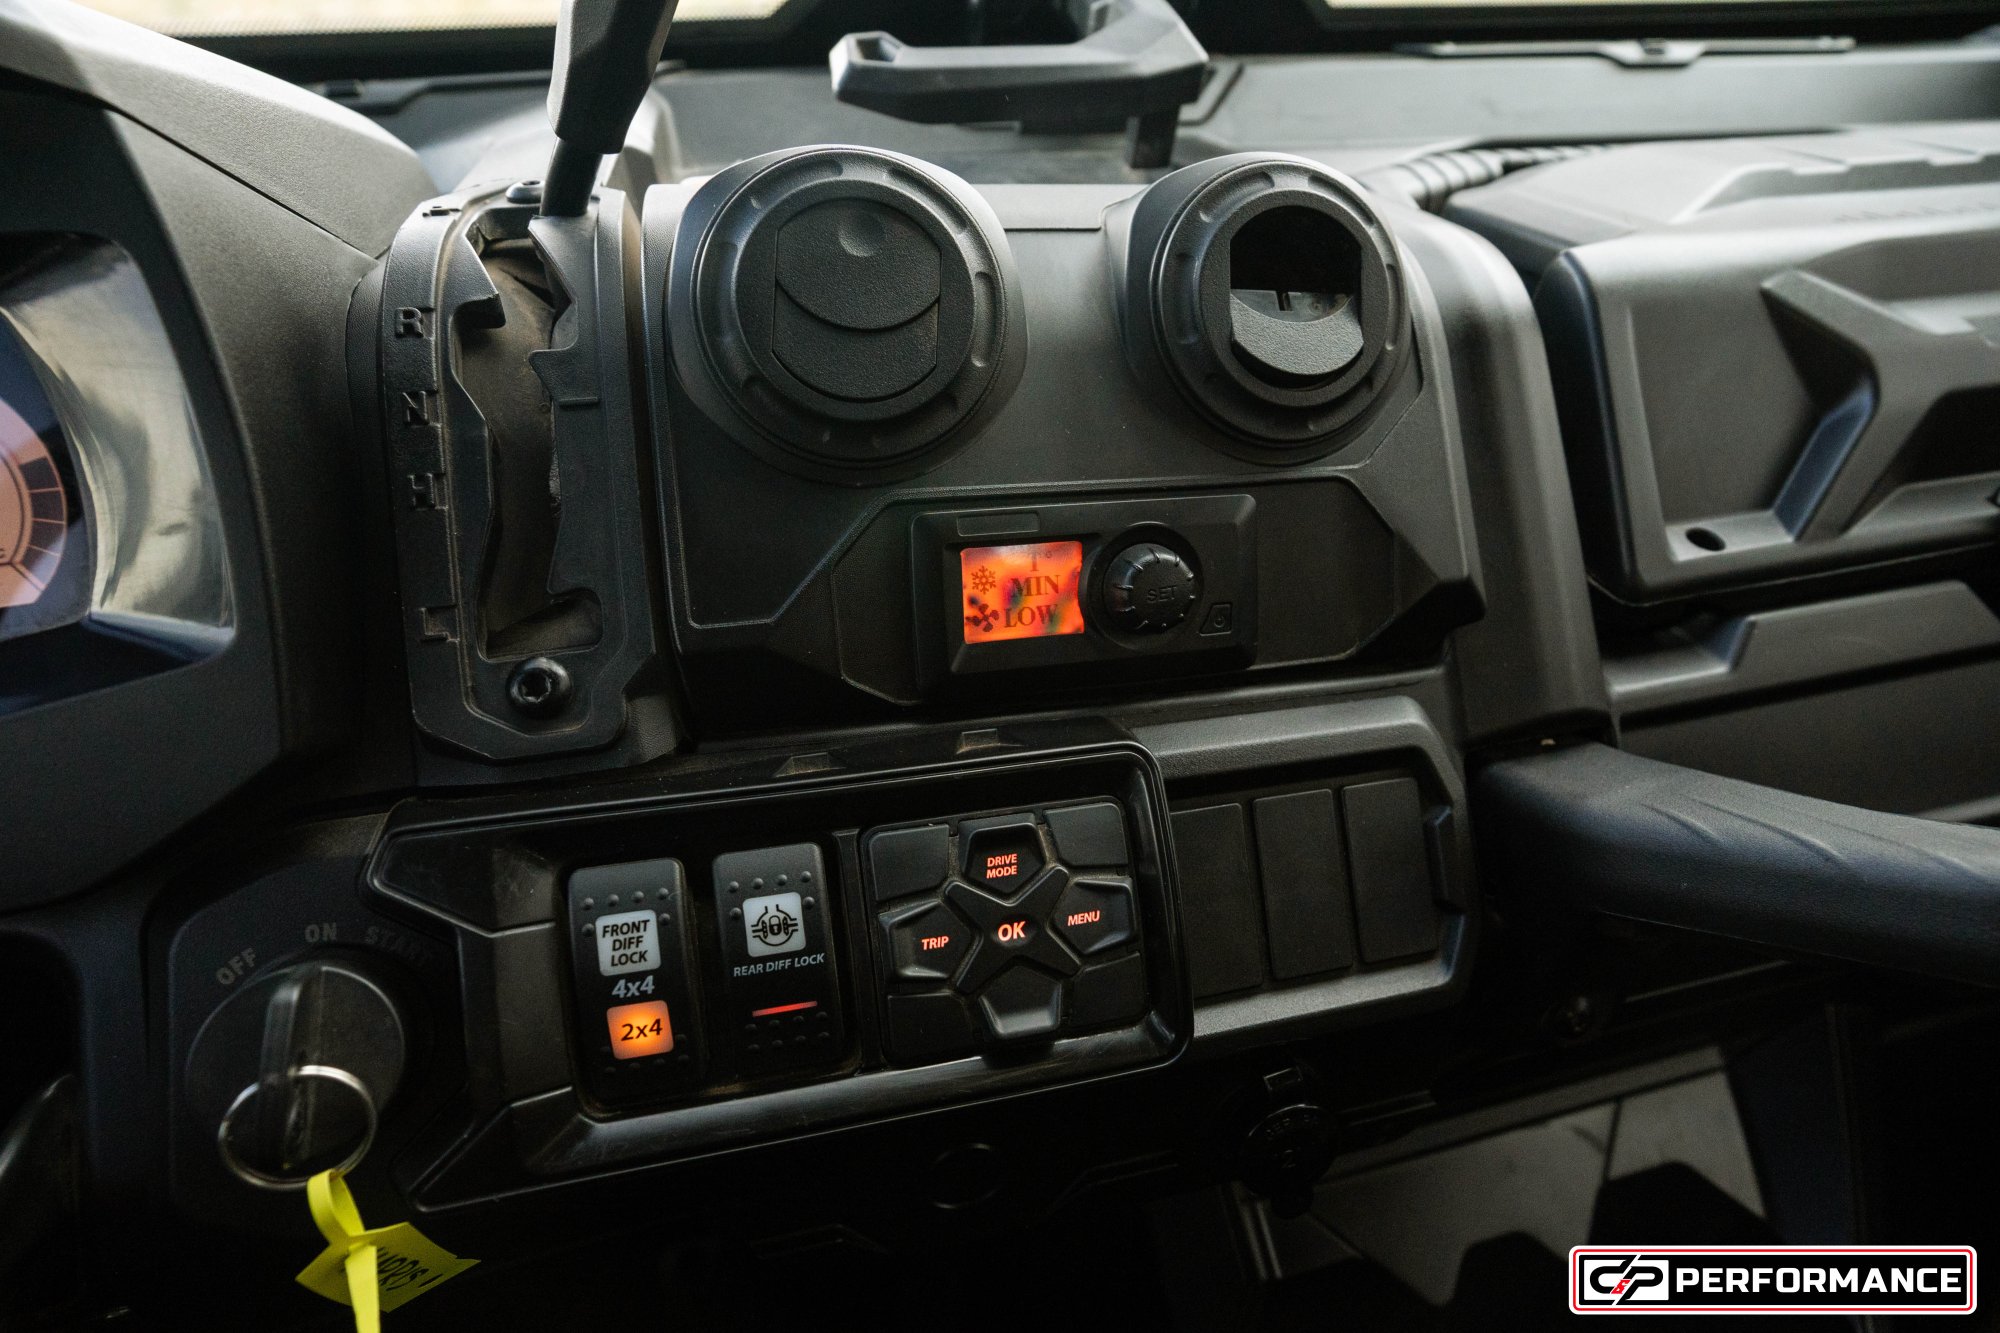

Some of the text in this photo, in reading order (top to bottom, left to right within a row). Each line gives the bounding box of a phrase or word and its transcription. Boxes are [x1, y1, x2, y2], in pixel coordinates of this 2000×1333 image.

[396, 307, 424, 338] R
[403, 391, 430, 424] N
[407, 473, 435, 509] H
[1011, 575, 1061, 598] MIN
[1147, 585, 1177, 603] SET
[419, 607, 450, 641] L
[1003, 603, 1058, 628] LOW
[986, 865, 1018, 879] MODE
[987, 853, 1018, 868] DRIVE
[602, 919, 651, 938] FRONT
[1067, 910, 1101, 926] MENU
[304, 921, 337, 944] ON
[921, 935, 950, 950] TRIP
[997, 921, 1027, 942] OK
[612, 936, 644, 952] DIFF
[215, 946, 258, 985] OFF
[610, 950, 648, 967] LOCK
[733, 952, 825, 977] REAR DIFF LOCK
[611, 974, 656, 999] 4x4
[620, 1018, 664, 1042] 2x4
